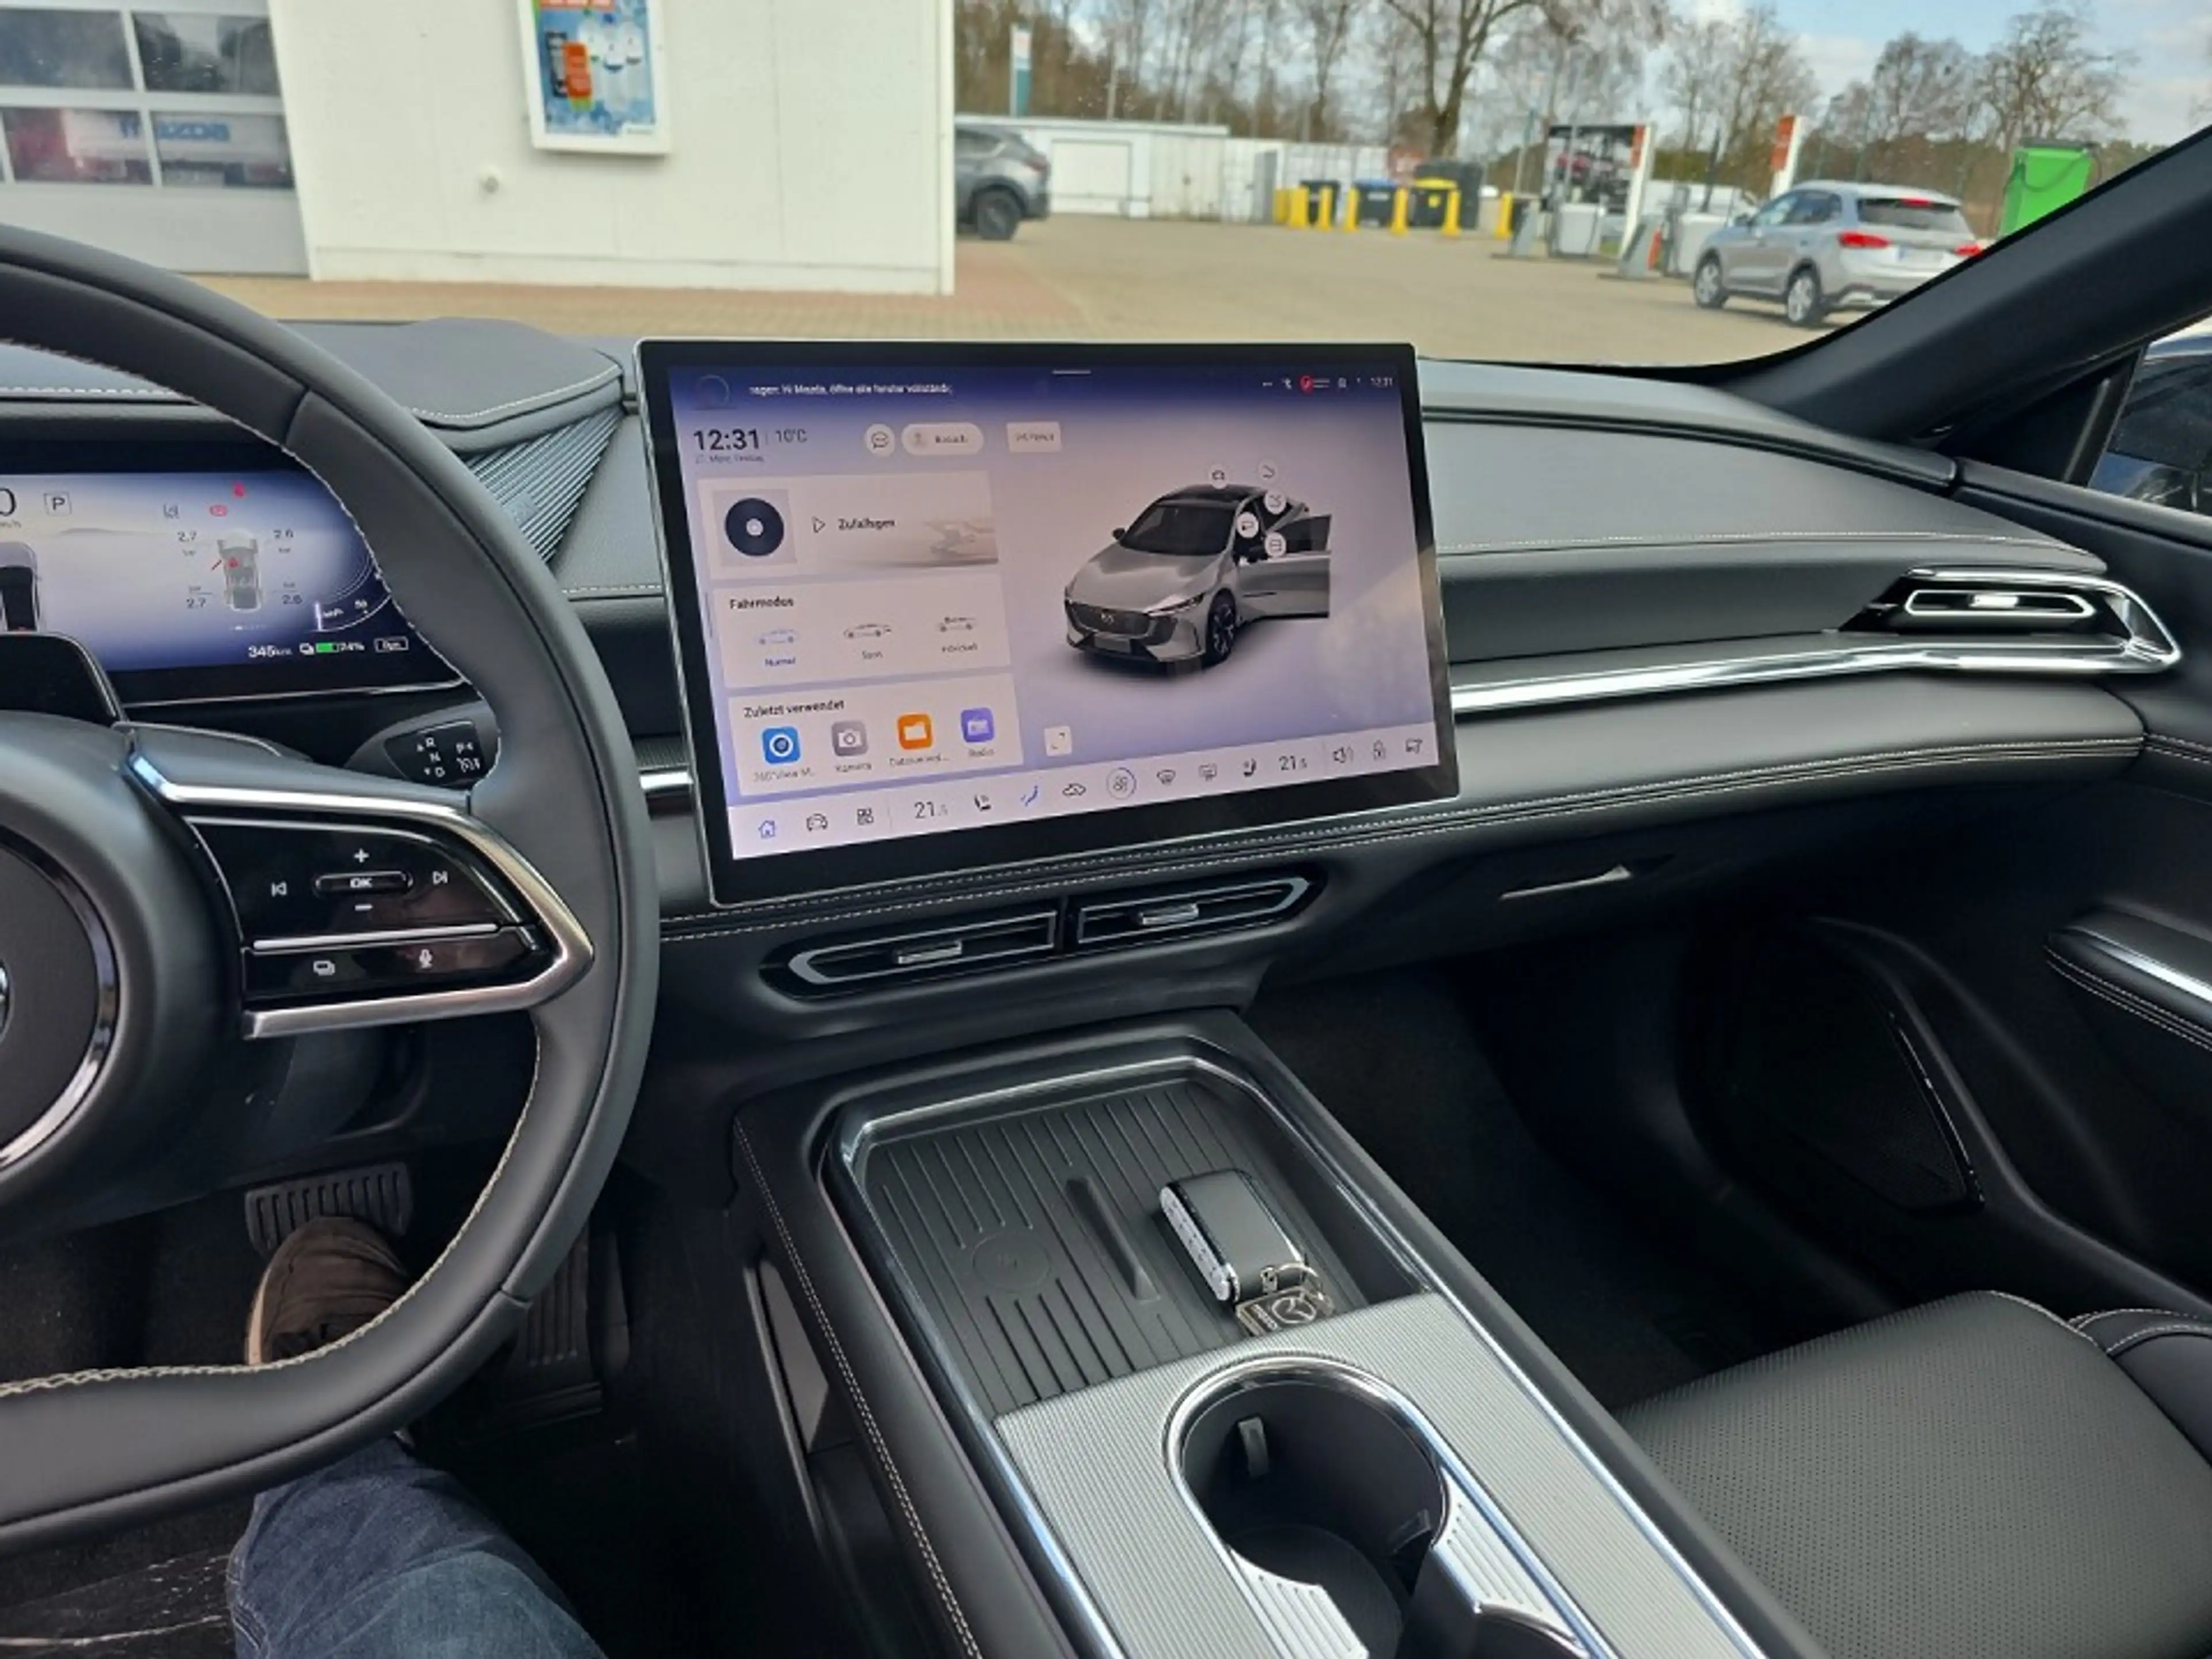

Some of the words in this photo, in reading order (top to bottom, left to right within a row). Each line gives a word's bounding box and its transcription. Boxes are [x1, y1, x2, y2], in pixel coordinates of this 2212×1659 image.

[694, 429, 759, 450] 12:31
[776, 429, 807, 443] 10°C
[53, 497, 65, 511] P
[744, 705, 784, 718] Zuletzt
[787, 700, 844, 713] verwendet
[426, 737, 436, 747] R
[350, 878, 372, 888] OK
